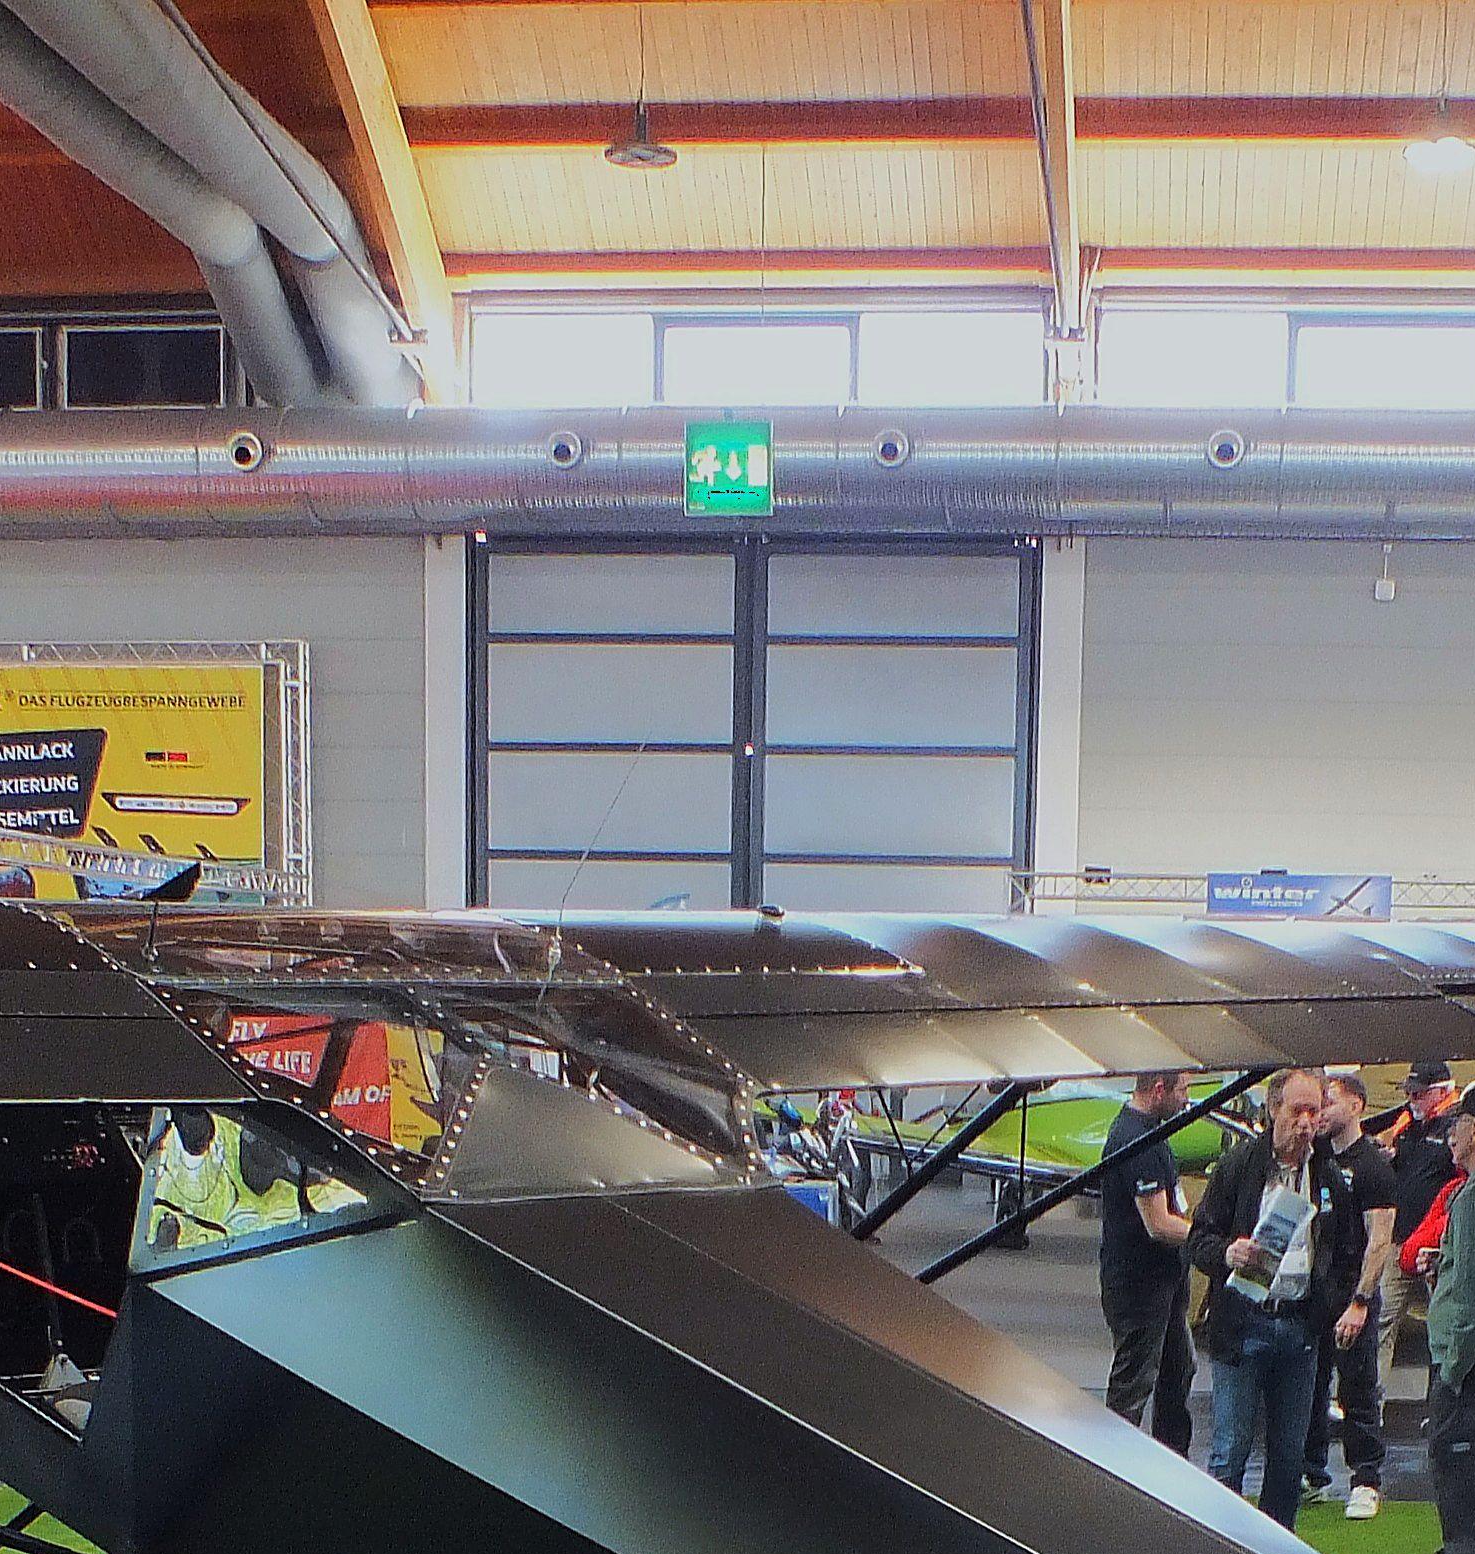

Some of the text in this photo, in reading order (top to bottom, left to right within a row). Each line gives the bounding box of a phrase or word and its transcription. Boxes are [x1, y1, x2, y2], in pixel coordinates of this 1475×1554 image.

[18, 695, 47, 709] DAS
[1213, 876, 1321, 901] winter
[273, 1051, 312, 1075] LIFE
